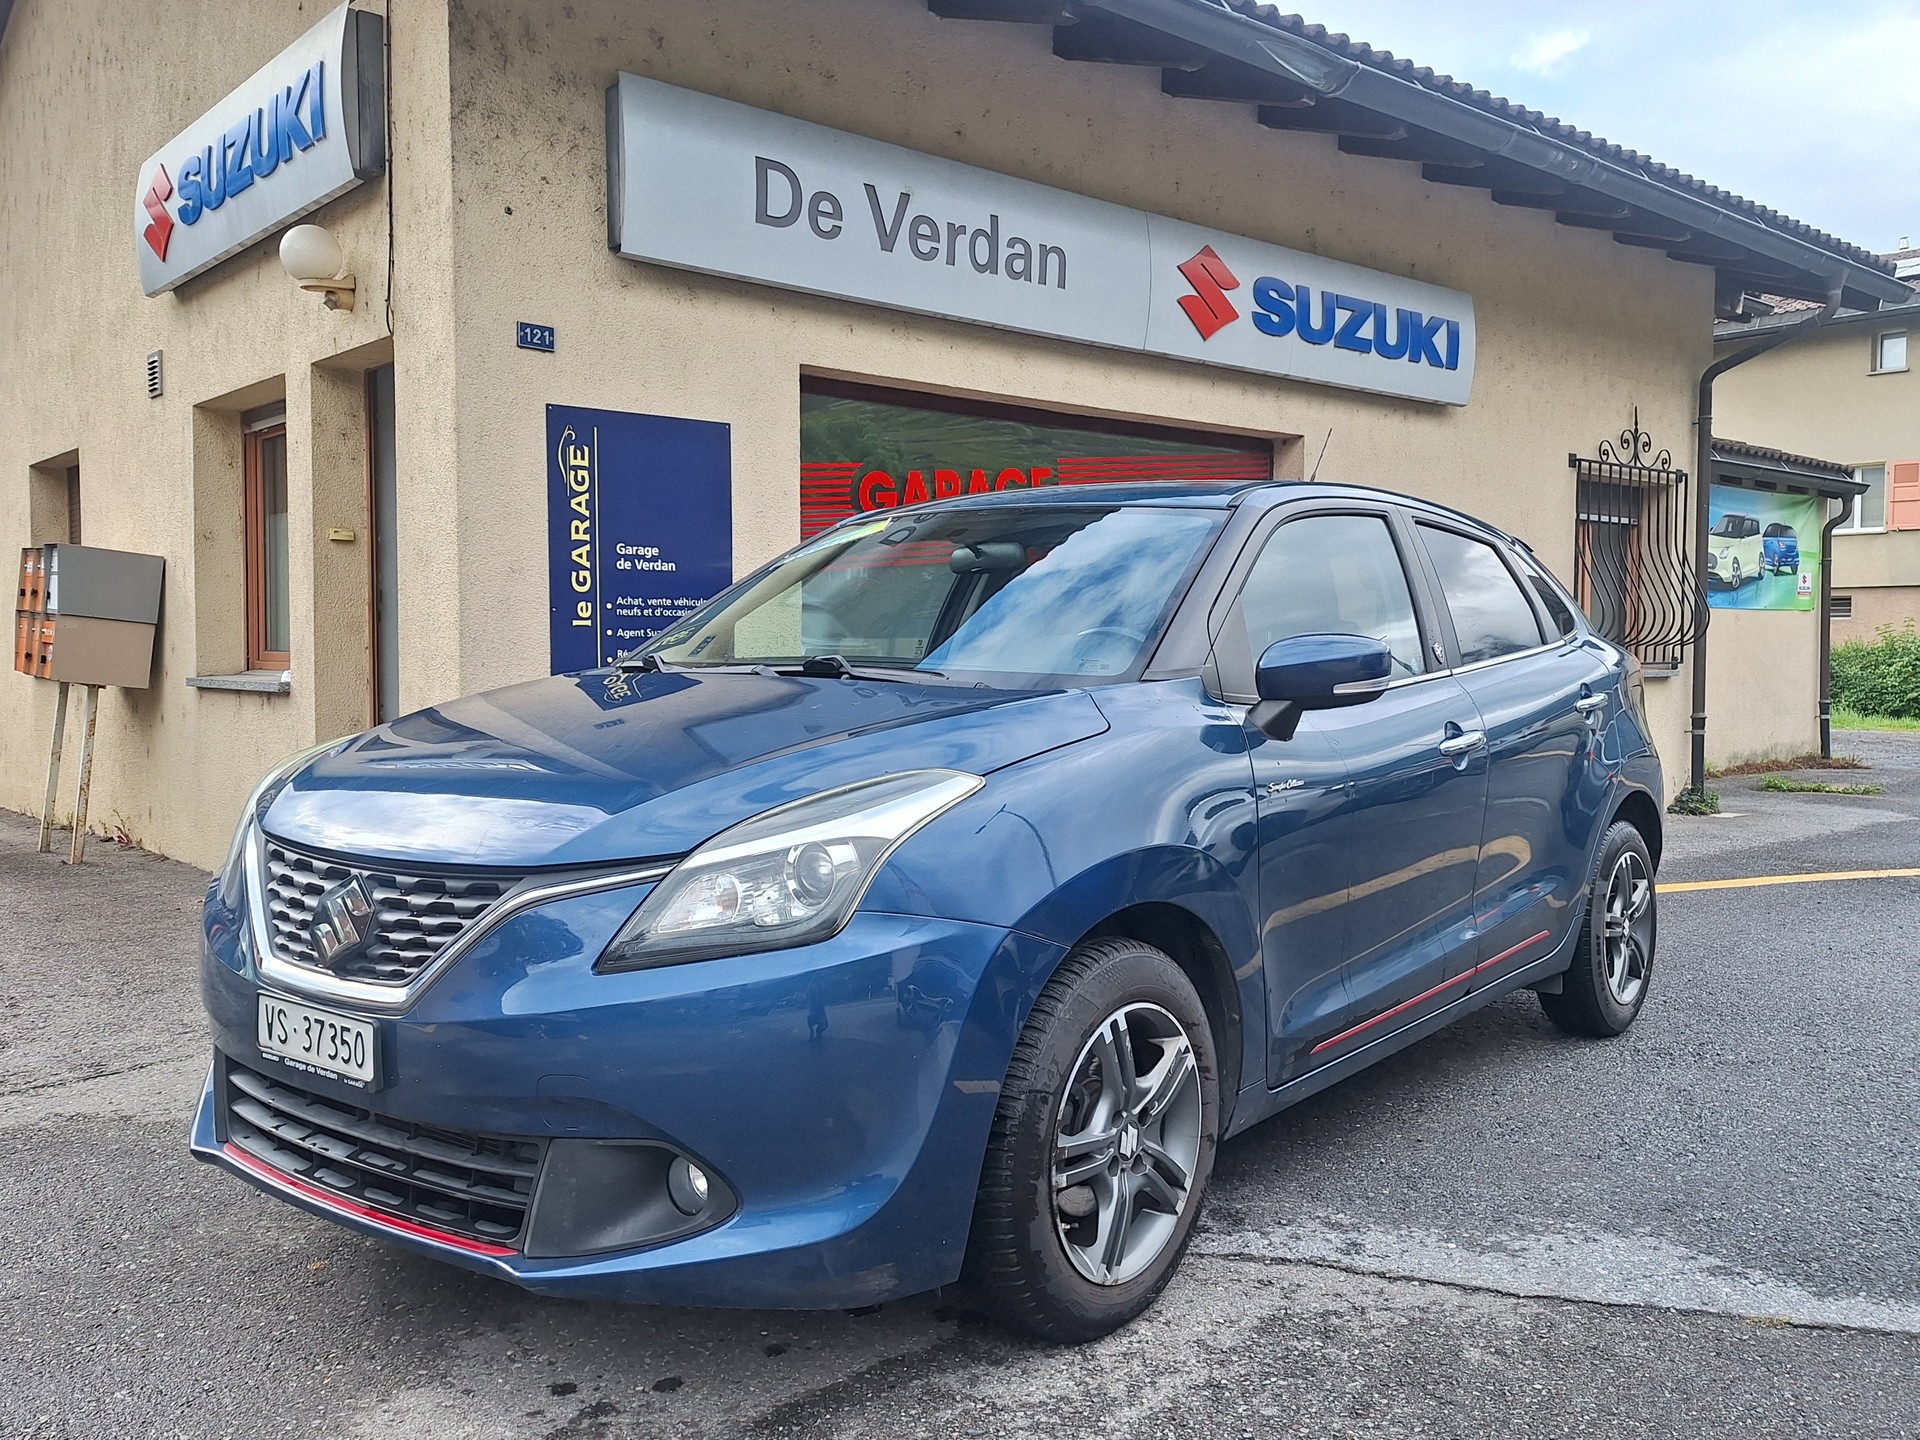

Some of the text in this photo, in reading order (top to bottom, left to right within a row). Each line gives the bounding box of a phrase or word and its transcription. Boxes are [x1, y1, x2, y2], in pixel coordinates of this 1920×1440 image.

[177, 60, 327, 226] SUZUKI
[754, 155, 1068, 291] De Verdan
[1251, 276, 1460, 371] SUZUKI
[524, 327, 550, 346] 121
[569, 444, 592, 627] le GARAGE
[616, 543, 660, 559] Garage
[616, 557, 676, 571] de Verdan
[616, 596, 645, 607] Achat,
[647, 598, 672, 606] vente
[616, 607, 642, 616] neufs
[643, 608, 653, 616] et
[616, 628, 645, 639] Agent
[284, 1057, 338, 1080] Garage de Verdan
